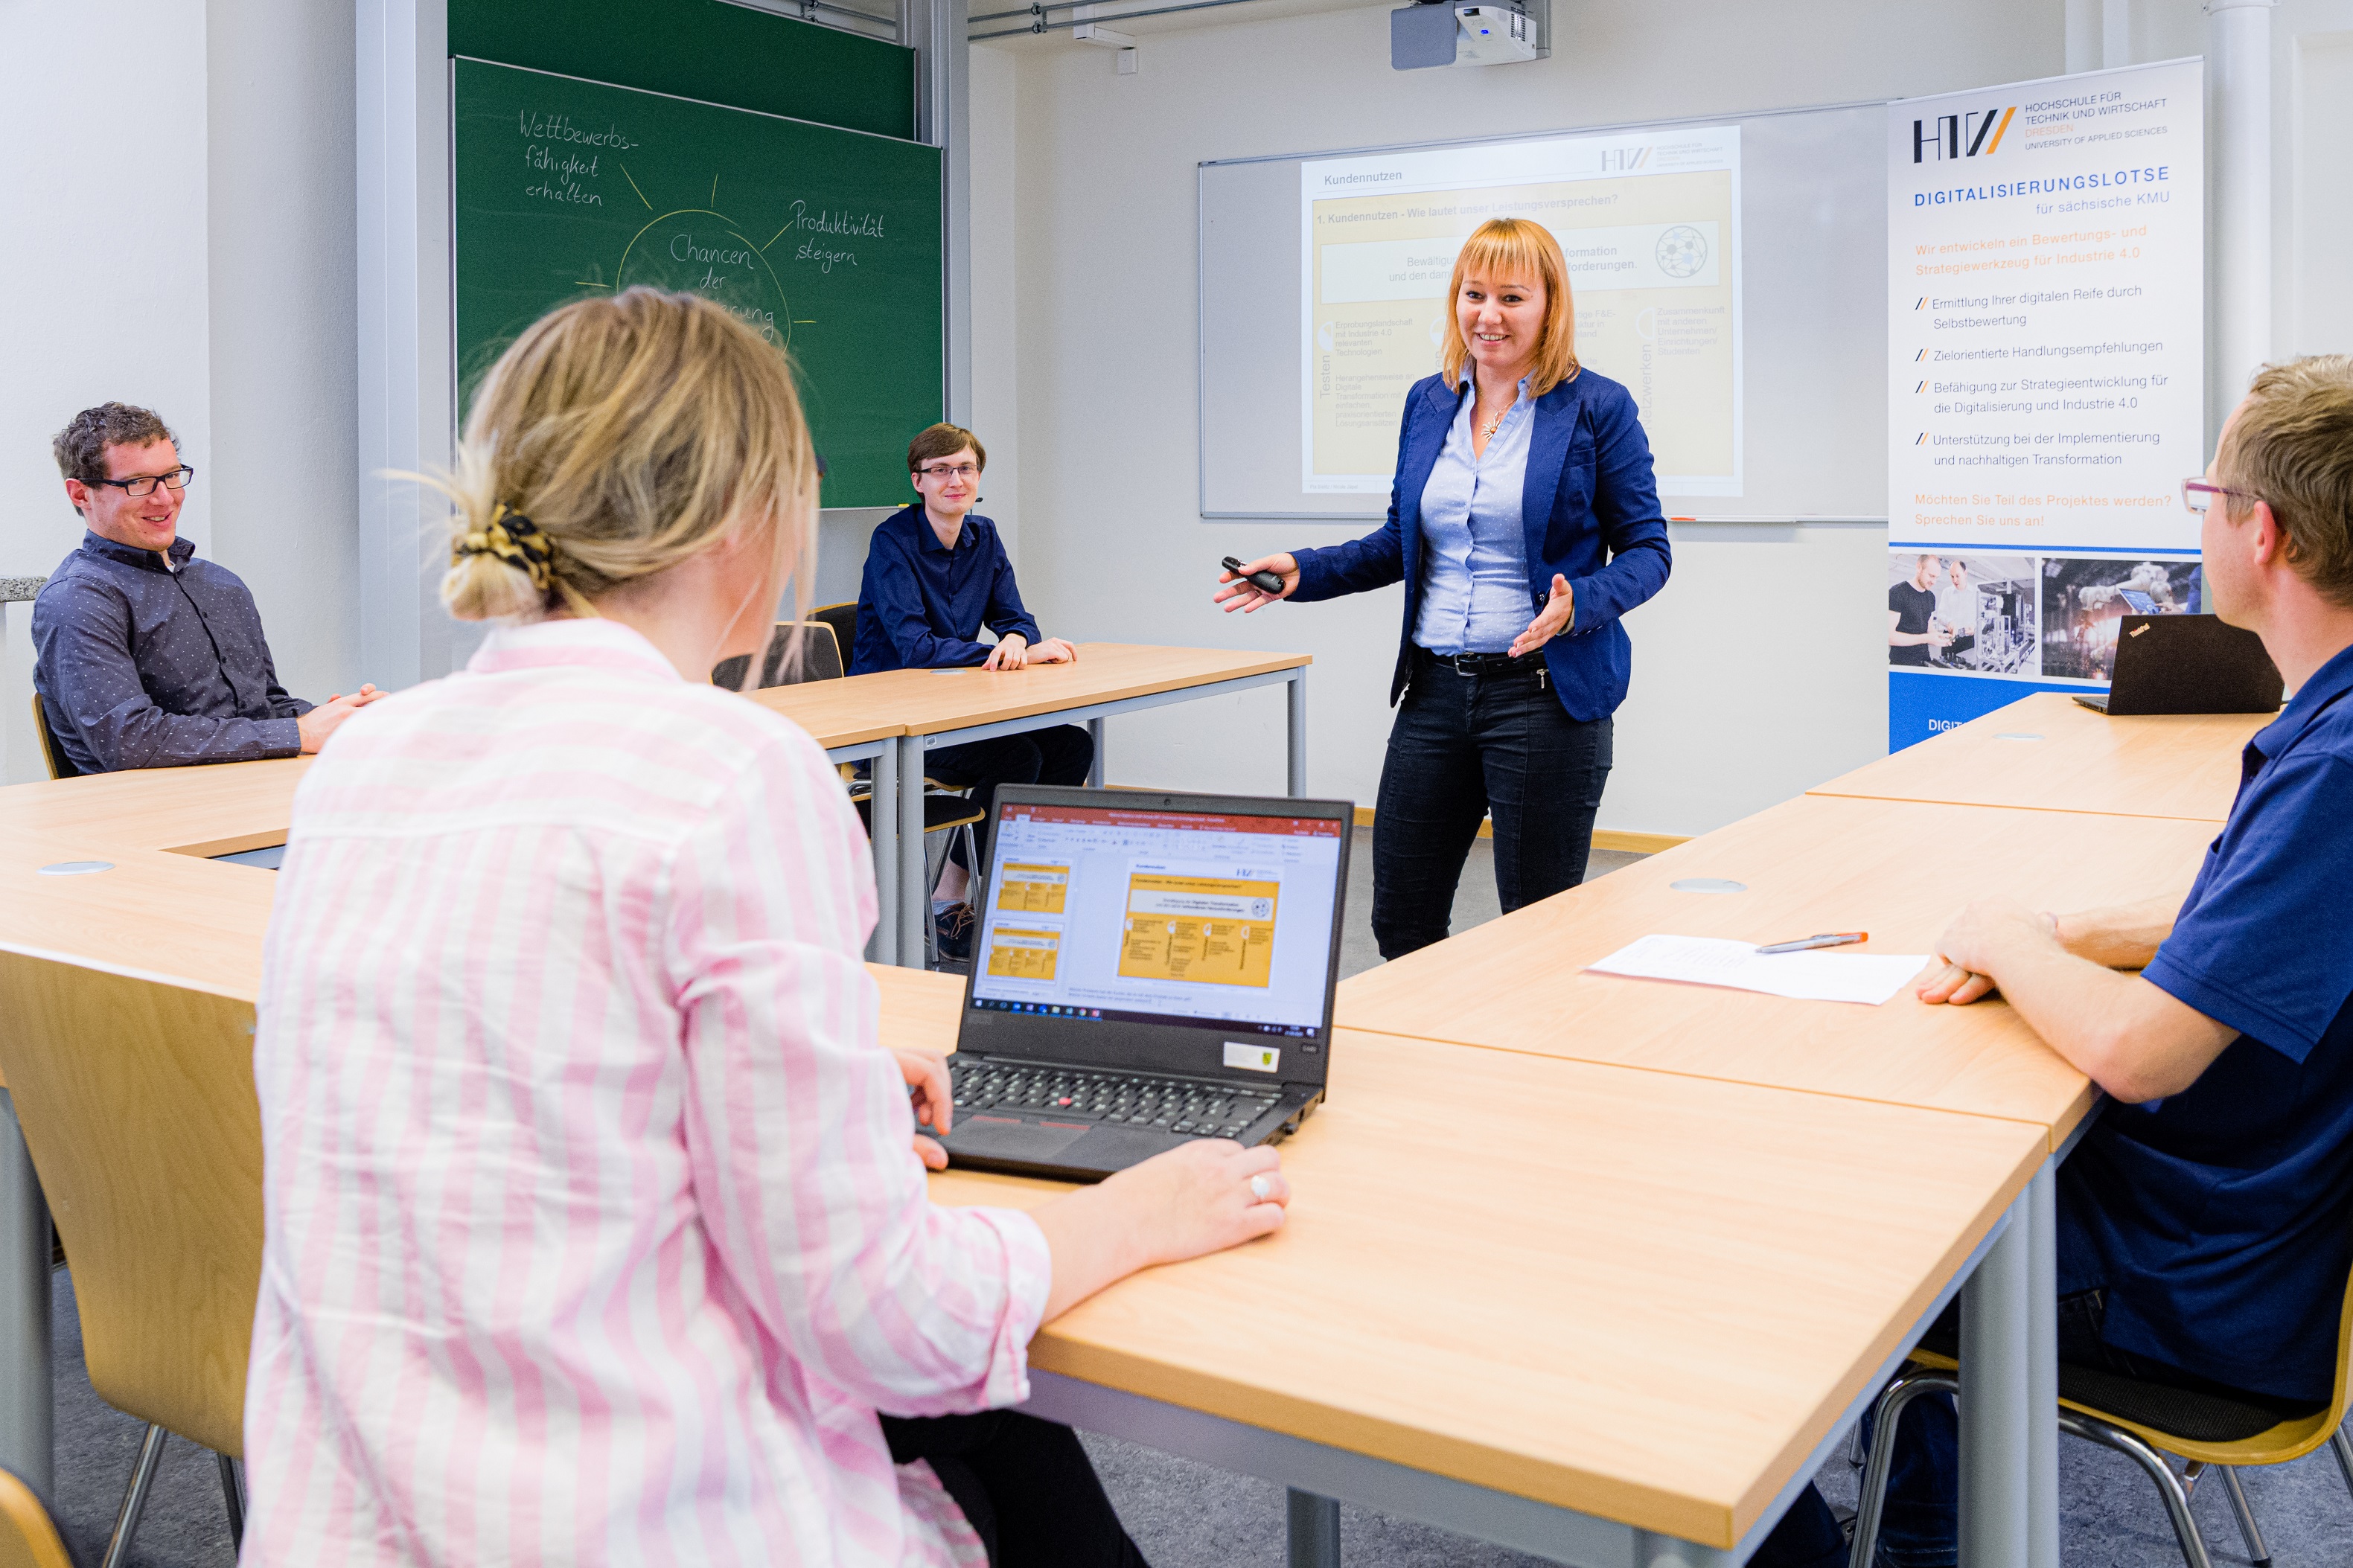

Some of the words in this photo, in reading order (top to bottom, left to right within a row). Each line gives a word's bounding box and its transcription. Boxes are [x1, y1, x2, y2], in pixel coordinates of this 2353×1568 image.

[2025, 95, 2098, 113] HOCHSCHULE
[2099, 92, 2121, 105] FÜR
[2025, 112, 2069, 125] TECHNIK
[2072, 108, 2095, 119] UND
[2098, 98, 2168, 117] WIRTSCHAFT
[520, 109, 639, 150] Wettbewerbs-
[2025, 124, 2073, 138] DRESDEN
[2025, 138, 2072, 150] UNIVERSITY
[2074, 135, 2087, 145] OF
[2087, 132, 2122, 143] APPLIED
[2124, 126, 2168, 138] SCIENCES
[526, 144, 598, 185] fähigkeit
[1324, 170, 1402, 186] Kundennutzen
[1915, 166, 2169, 206] DIGITALISIERUNGSLOTSE
[526, 182, 603, 206] erhalten
[1492, 193, 1618, 212] Leistungsversprechen?
[2036, 203, 2054, 214] für
[2058, 196, 2131, 213] sächsische
[2137, 191, 2169, 205] KMU
[789, 199, 885, 237] Produktivität
[1316, 215, 1325, 225] 1.
[1328, 211, 1398, 224] Kundennutzen
[1407, 208, 1425, 218] Wie
[1428, 205, 1457, 217] lautet
[1460, 203, 1489, 214] unser
[1915, 245, 1935, 255] Wir
[1939, 238, 2005, 254] entwickeln
[2009, 236, 2027, 248] ein
[2031, 230, 2116, 246] Bewertungs-
[2121, 224, 2147, 238] und
[671, 234, 754, 270] Chancen
[795, 238, 858, 274] steigern
[1564, 246, 1618, 257] formation
[1567, 260, 1638, 272] forderungen.
[1915, 258, 2030, 276] Strategiewerkzeug
[2034, 255, 2052, 266] für
[2057, 249, 2115, 264] Industrie
[2119, 246, 2141, 259] 4.0
[700, 266, 727, 289] der
[1389, 272, 1406, 281] und
[1409, 271, 1427, 281] den
[1932, 297, 1988, 310] Ermittlung
[1992, 295, 2017, 305] Ihrer
[2020, 290, 2069, 306] digitalen
[2073, 287, 2104, 300] Reife
[2107, 285, 2142, 298] durch
[1657, 305, 1725, 316] Zusammenkunft
[1335, 318, 1413, 330] Erprobungslandschaft
[1657, 318, 1670, 326] mit
[1673, 318, 1708, 326] anderen
[1934, 316, 2026, 330] Selbstbewertung
[1335, 330, 1347, 339] mit
[1348, 329, 1379, 338] Industrie
[1380, 328, 1392, 336] 4.0
[1335, 339, 1373, 347] relevanten
[1657, 348, 1701, 356] Studenten
[1934, 348, 2009, 361] Zielorientierte
[2012, 342, 2162, 358] Handlungsempfehlungen
[1335, 348, 1382, 357] Technologien
[1320, 354, 1331, 399] Testen
[1335, 373, 1404, 383] Herangehensweise
[1935, 382, 1996, 395] Befähigung
[2000, 382, 2017, 391] zur
[2021, 376, 2147, 392] Strategieentwicklung
[2151, 374, 2168, 386] für
[1335, 383, 1362, 392] Digitale
[1639, 343, 1653, 429] Netzwerken
[1335, 392, 1388, 400] Transformation
[1934, 403, 1951, 414] die
[1955, 401, 2032, 415] Digitalisierung
[2036, 400, 2059, 411] und
[2063, 398, 2115, 410] Industrie
[2119, 397, 2138, 409] 4.0
[1933, 435, 2010, 447] Unterstützung
[2014, 433, 2031, 444] bei
[2034, 433, 2055, 444] der
[2058, 432, 2159, 446] Implementierung
[1934, 455, 1955, 466] und
[1958, 454, 2028, 468] nachhaltigen
[2032, 453, 2121, 465] Transformation
[1915, 493, 1967, 505] Möchten
[1972, 494, 1990, 505] Sie
[1994, 493, 2014, 505] Teil
[2019, 494, 2042, 506] des
[2046, 494, 2109, 509] Projektes
[2113, 495, 2172, 507] werden?
[1915, 513, 1972, 527] Sprechen
[1976, 514, 1995, 525] Sie
[1999, 517, 2021, 527] uns
[2025, 515, 2044, 527] an!
